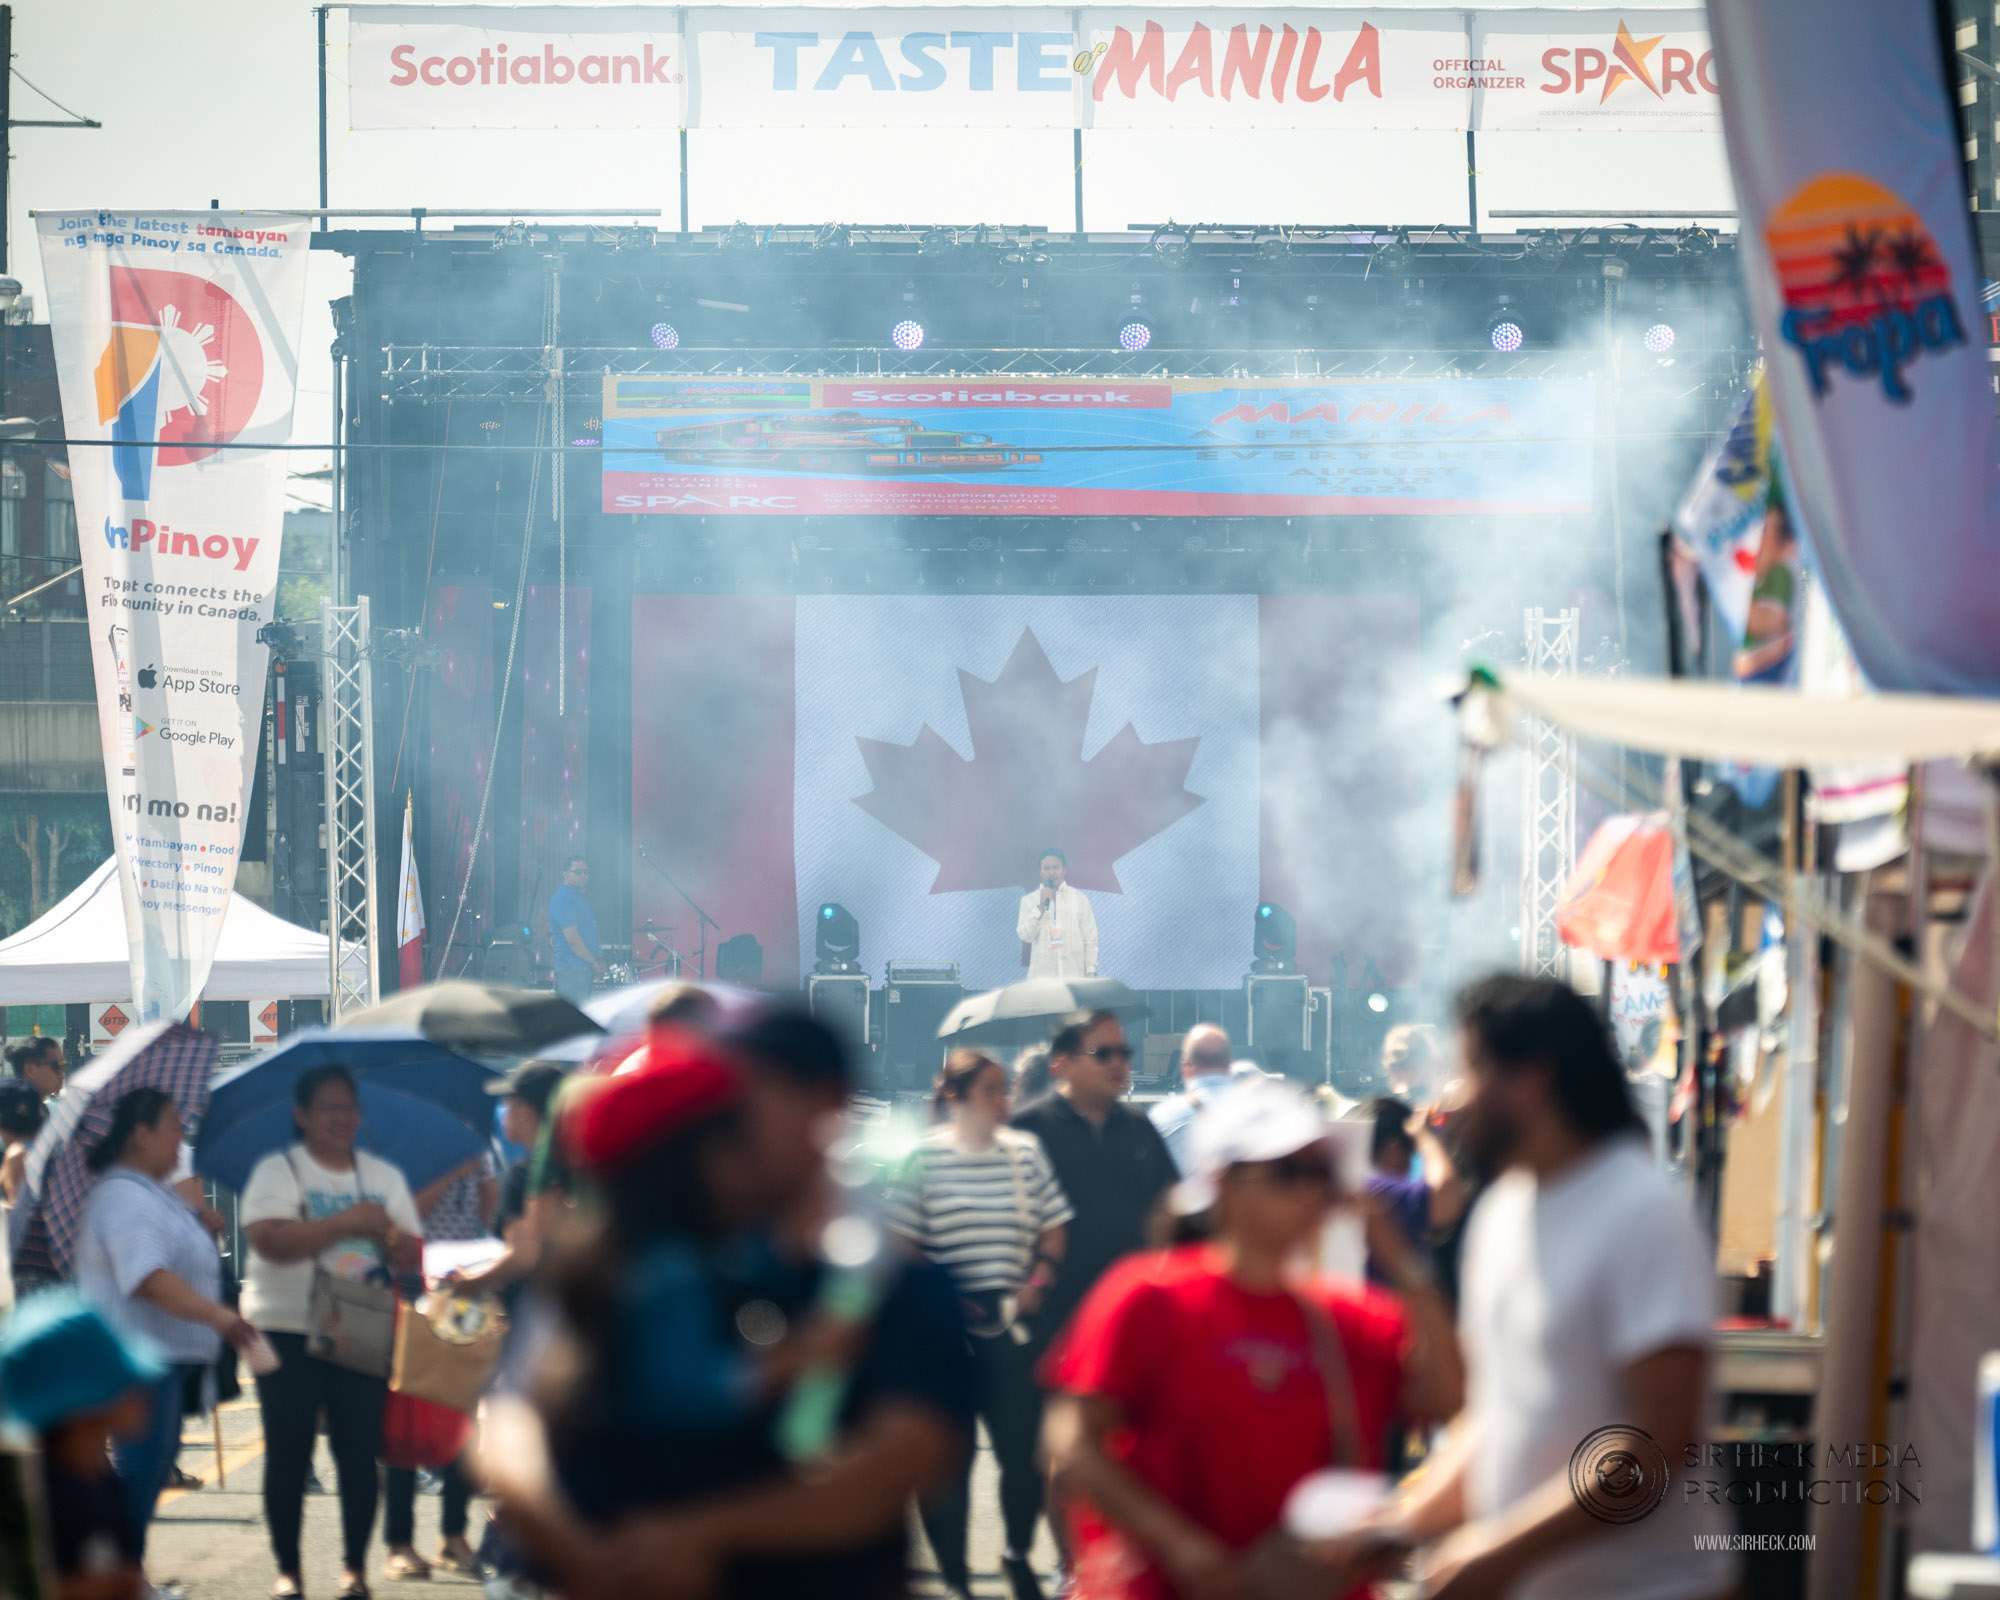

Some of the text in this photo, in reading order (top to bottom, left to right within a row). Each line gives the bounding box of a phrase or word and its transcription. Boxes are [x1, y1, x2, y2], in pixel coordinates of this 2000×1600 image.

[389, 43, 671, 87] Scotiabank
[754, 19, 1383, 103] TASTE of MANILA
[1432, 58, 1506, 72] OFFICIAL
[1432, 76, 1525, 90] ORGANIZER
[57, 210, 288, 244] Join the latest tambayan
[64, 232, 283, 259] ng mga Pinoy sa Canada.
[851, 390, 1131, 402] Scotiabank
[1213, 402, 1512, 424] MANILA
[1255, 429, 1526, 440] FESTIVA
[1287, 467, 1465, 477] AUGUST
[143, 582, 227, 600] connects
[233, 589, 263, 604] the
[177, 600, 193, 615] in
[197, 604, 262, 622] Canada.
[162, 665, 199, 675] Download
[162, 675, 240, 696] App Store
[160, 718, 175, 726] GET
[185, 719, 197, 727] ON
[160, 727, 235, 749] Google Play
[147, 799, 190, 818] mo
[196, 803, 237, 824] na!
[209, 844, 234, 855] Food
[193, 863, 224, 876] Pinoy
